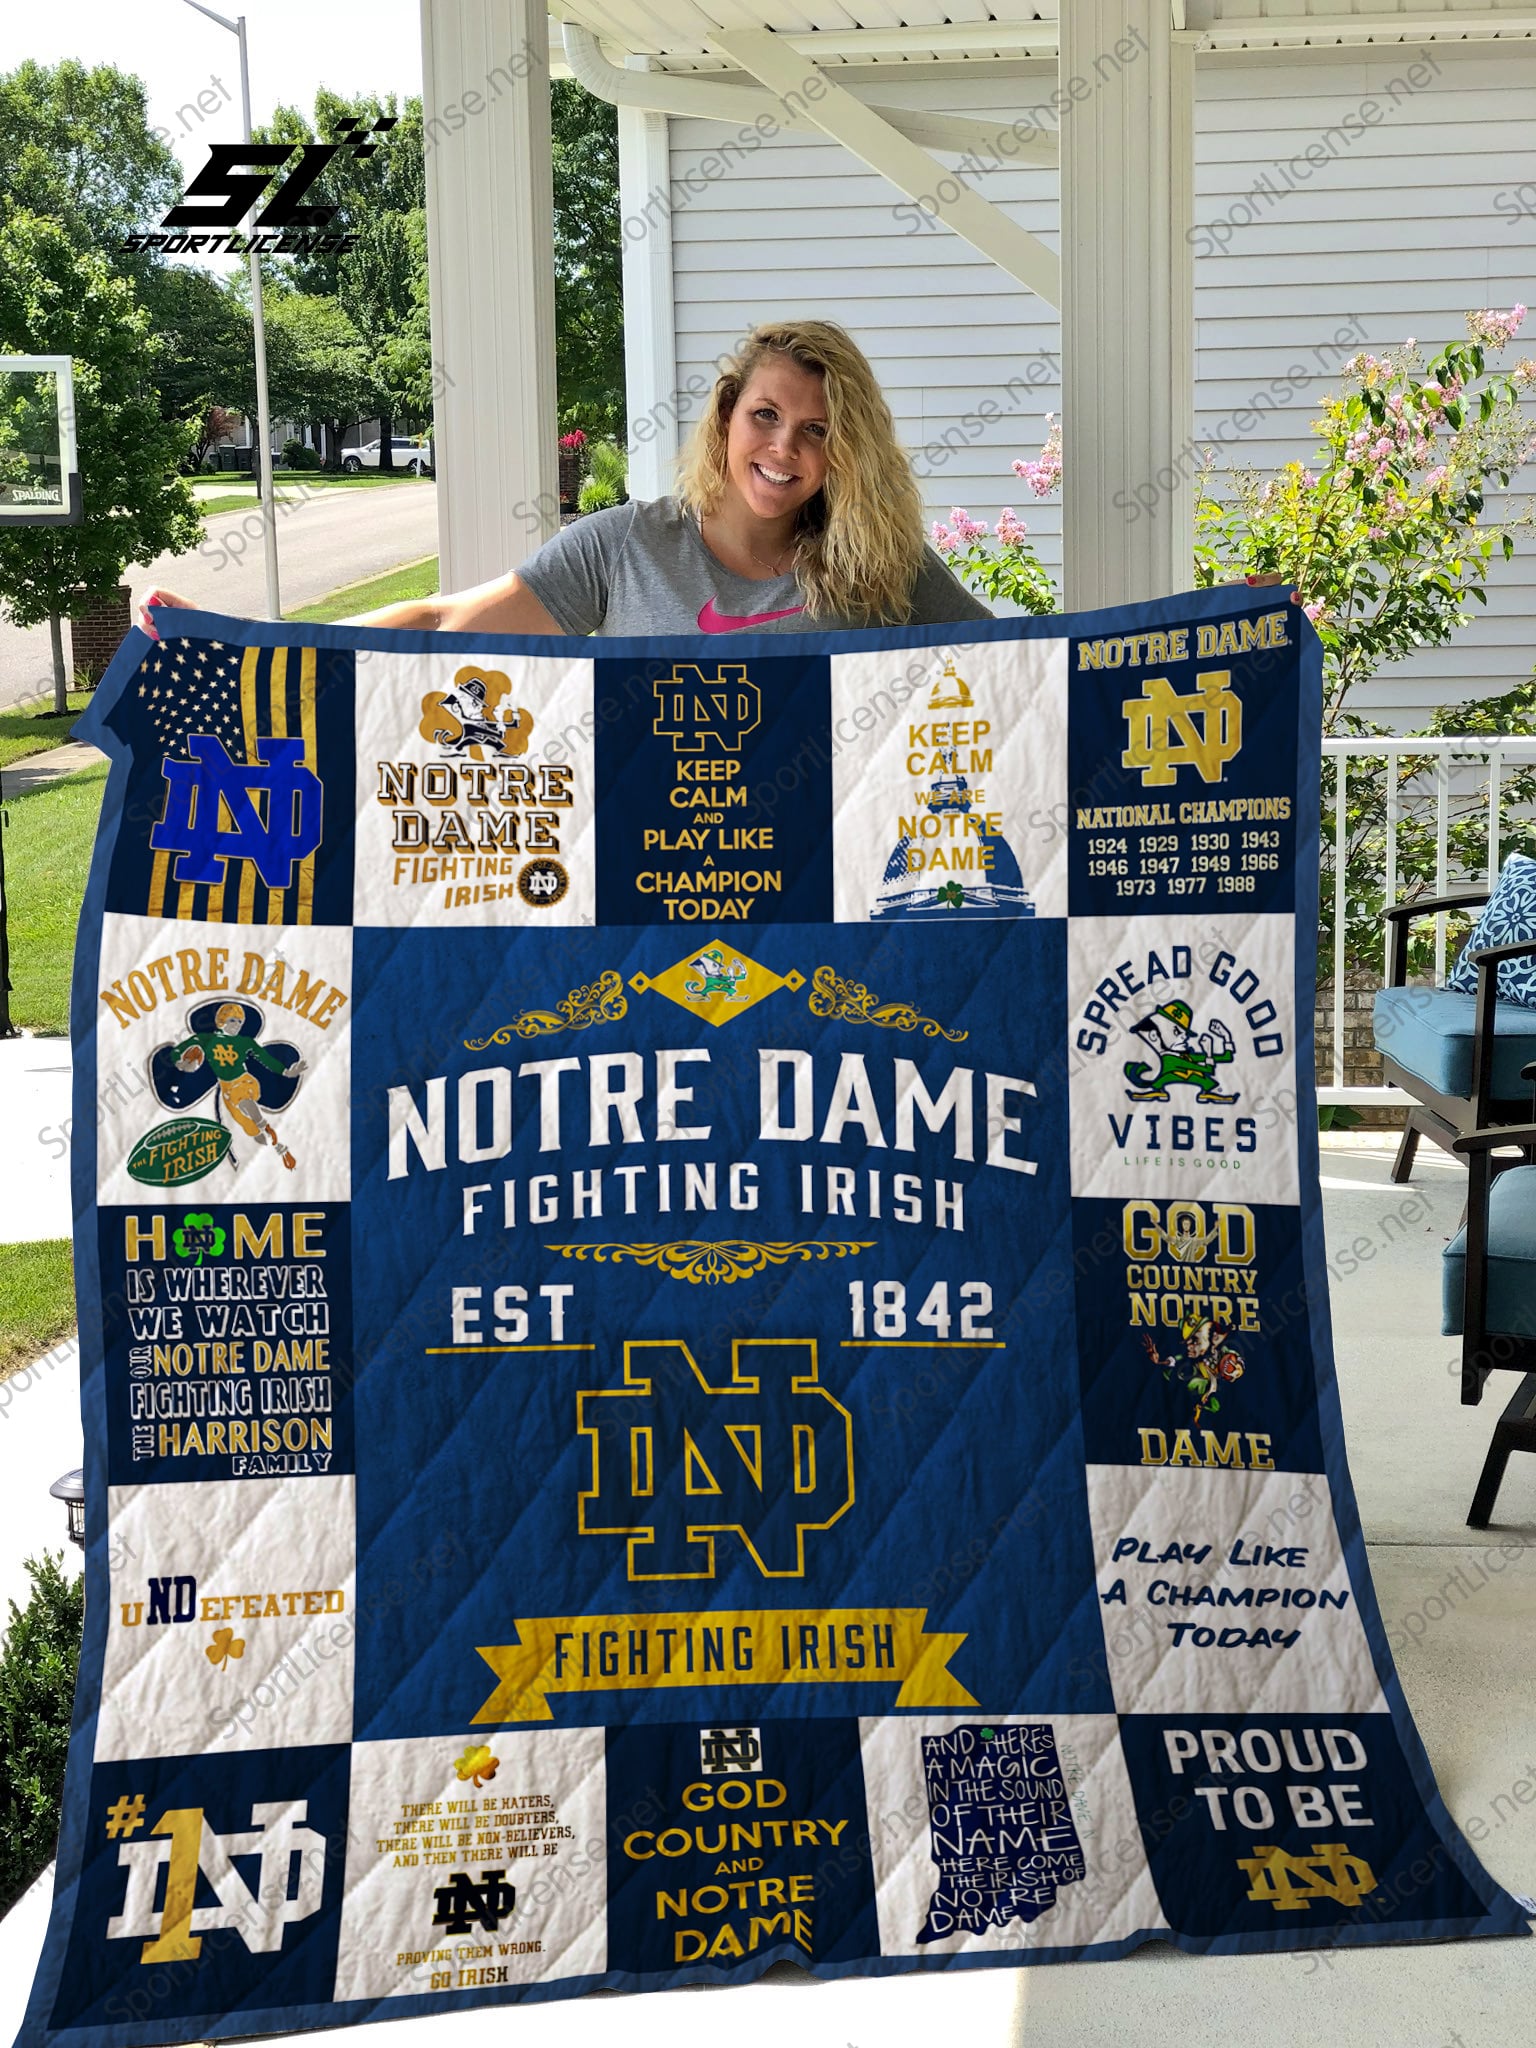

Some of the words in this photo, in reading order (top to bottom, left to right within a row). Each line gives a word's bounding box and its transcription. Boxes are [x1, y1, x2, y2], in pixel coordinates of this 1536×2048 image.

[12, 489, 61, 502] SPALDING
[1078, 627, 1189, 671] NOTRE
[1198, 610, 1289, 657] DAME
[908, 721, 991, 749] KEEP
[676, 760, 741, 781] KEEP
[906, 749, 993, 776] CALM
[378, 762, 574, 808] NOTRE
[669, 787, 747, 808] CALM
[914, 791, 944, 805] WE
[949, 789, 985, 804] ARE
[694, 813, 724, 825] AND
[898, 813, 1003, 840] NOTRE
[1077, 801, 1176, 829] NATIONAL
[1179, 797, 1291, 825] CHAMPIONS
[392, 810, 560, 854] DAME
[644, 829, 710, 850] PLAY
[719, 828, 773, 849] LIKE
[1088, 837, 1128, 855] 1924
[1139, 836, 1178, 853] 1929
[1191, 833, 1230, 851] 1930
[1241, 831, 1279, 849] 1943
[394, 858, 513, 884] FIGHTING
[703, 855, 714, 866] A
[906, 846, 995, 873] DAME
[1088, 858, 1128, 876] 1946
[1140, 857, 1179, 874] 1947
[1191, 855, 1230, 873] 1949
[1241, 854, 1279, 870] 1966
[444, 881, 514, 910] IRISH
[635, 871, 782, 893] CHAMPION
[1116, 878, 1156, 896] 1973
[1167, 877, 1207, 894] 1977
[1217, 876, 1255, 893] 1988
[664, 899, 755, 920] TODAY
[99, 948, 229, 1030] NOTRE
[236, 951, 349, 1030] DAME
[1077, 946, 1191, 1055] SPREAD
[1209, 951, 1283, 1058] GOOD
[386, 1048, 711, 1181] NOTRE
[758, 1048, 1039, 1176] DAME
[1108, 1114, 1256, 1152] VIBES
[133, 1158, 146, 1169] THE
[149, 1129, 221, 1166] FIGHTING
[163, 1142, 217, 1184] IRISH
[1124, 1156, 1161, 1166] LIFE
[1170, 1157, 1185, 1167] IS
[1194, 1158, 1241, 1170] GOOD
[463, 1162, 760, 1236] FIGHTING
[801, 1163, 966, 1232] IRISH
[1123, 1200, 1256, 1265] GOD
[127, 1269, 155, 1303] IS
[164, 1265, 327, 1301] WHEREVER
[1127, 1264, 1258, 1294] COUNTRY
[129, 1306, 183, 1340] WE
[196, 1302, 330, 1338] WATCH
[450, 1284, 574, 1345] EST
[849, 1280, 995, 1341] 1842
[1129, 1293, 1260, 1332] NOTRE
[129, 1345, 152, 1379] OUR
[153, 1341, 245, 1377] NOTRE
[253, 1339, 330, 1372] DAME
[130, 1379, 252, 1419] FIGHTING
[260, 1376, 332, 1414] IRISH
[132, 1424, 155, 1461] THE
[159, 1417, 332, 1457] HARRISON
[1137, 1428, 1275, 1470] DAME
[232, 1453, 332, 1475] FAMILY
[1112, 1537, 1212, 1564] PLAY
[1229, 1539, 1309, 1567] LIKE
[1100, 1579, 1127, 1605] A
[1147, 1579, 1349, 1610] CHAMPION
[1167, 1623, 1301, 1649] TODAY
[555, 1625, 753, 1679] FIGHTING
[781, 1623, 896, 1670] IRISH
[924, 1729, 975, 1756] AND
[1163, 1728, 1368, 1774] PROUD
[926, 1757, 944, 1779] A
[951, 1756, 1058, 1779] MAGIC
[682, 1779, 787, 1812] GOD
[928, 1780, 949, 1802] IN
[952, 1779, 996, 1802] THE
[999, 1778, 1064, 1801] SOUND
[402, 1802, 442, 1817] THERE
[447, 1800, 478, 1814] WILL
[483, 1798, 497, 1810] BE
[502, 1795, 554, 1809] HATERS,
[932, 1803, 972, 1828] OF
[977, 1801, 1072, 1827] THEIR
[1194, 1786, 1275, 1830] TO
[1286, 1784, 1375, 1828] BE
[394, 1820, 434, 1834] THERE
[439, 1818, 470, 1831] WILL
[475, 1816, 489, 1828] BE
[494, 1811, 559, 1826] DOUBTERS,
[376, 1838, 417, 1853] THERE
[422, 1836, 453, 1849] WILL
[458, 1834, 472, 1846] BE
[477, 1826, 576, 1845] NON-BELIEVERS,
[623, 1820, 848, 1860] COUNTRY
[933, 1826, 1080, 1857] NAME
[393, 1855, 419, 1868] AND
[424, 1851, 456, 1865] THEN
[462, 1848, 502, 1861] THERE
[508, 1845, 538, 1858] WILL
[543, 1843, 558, 1855] BE
[714, 1857, 764, 1875] AND
[940, 1857, 1012, 1873] HERE
[1017, 1853, 1083, 1871] COME
[943, 1875, 988, 1889] THE
[990, 1872, 1060, 1887] IRISH
[1063, 1867, 1086, 1881] OF
[656, 1874, 815, 1920] NOTRE
[934, 1888, 1055, 1908] NOTRE
[930, 1906, 1014, 1933] DAME
[675, 1908, 813, 1963] DAME
[396, 1950, 452, 1966] PROVING
[457, 1946, 493, 1960] THEM
[498, 1941, 546, 1956] WRONG.
[430, 1972, 451, 1990] GO
[457, 1966, 509, 1987] IRISH
